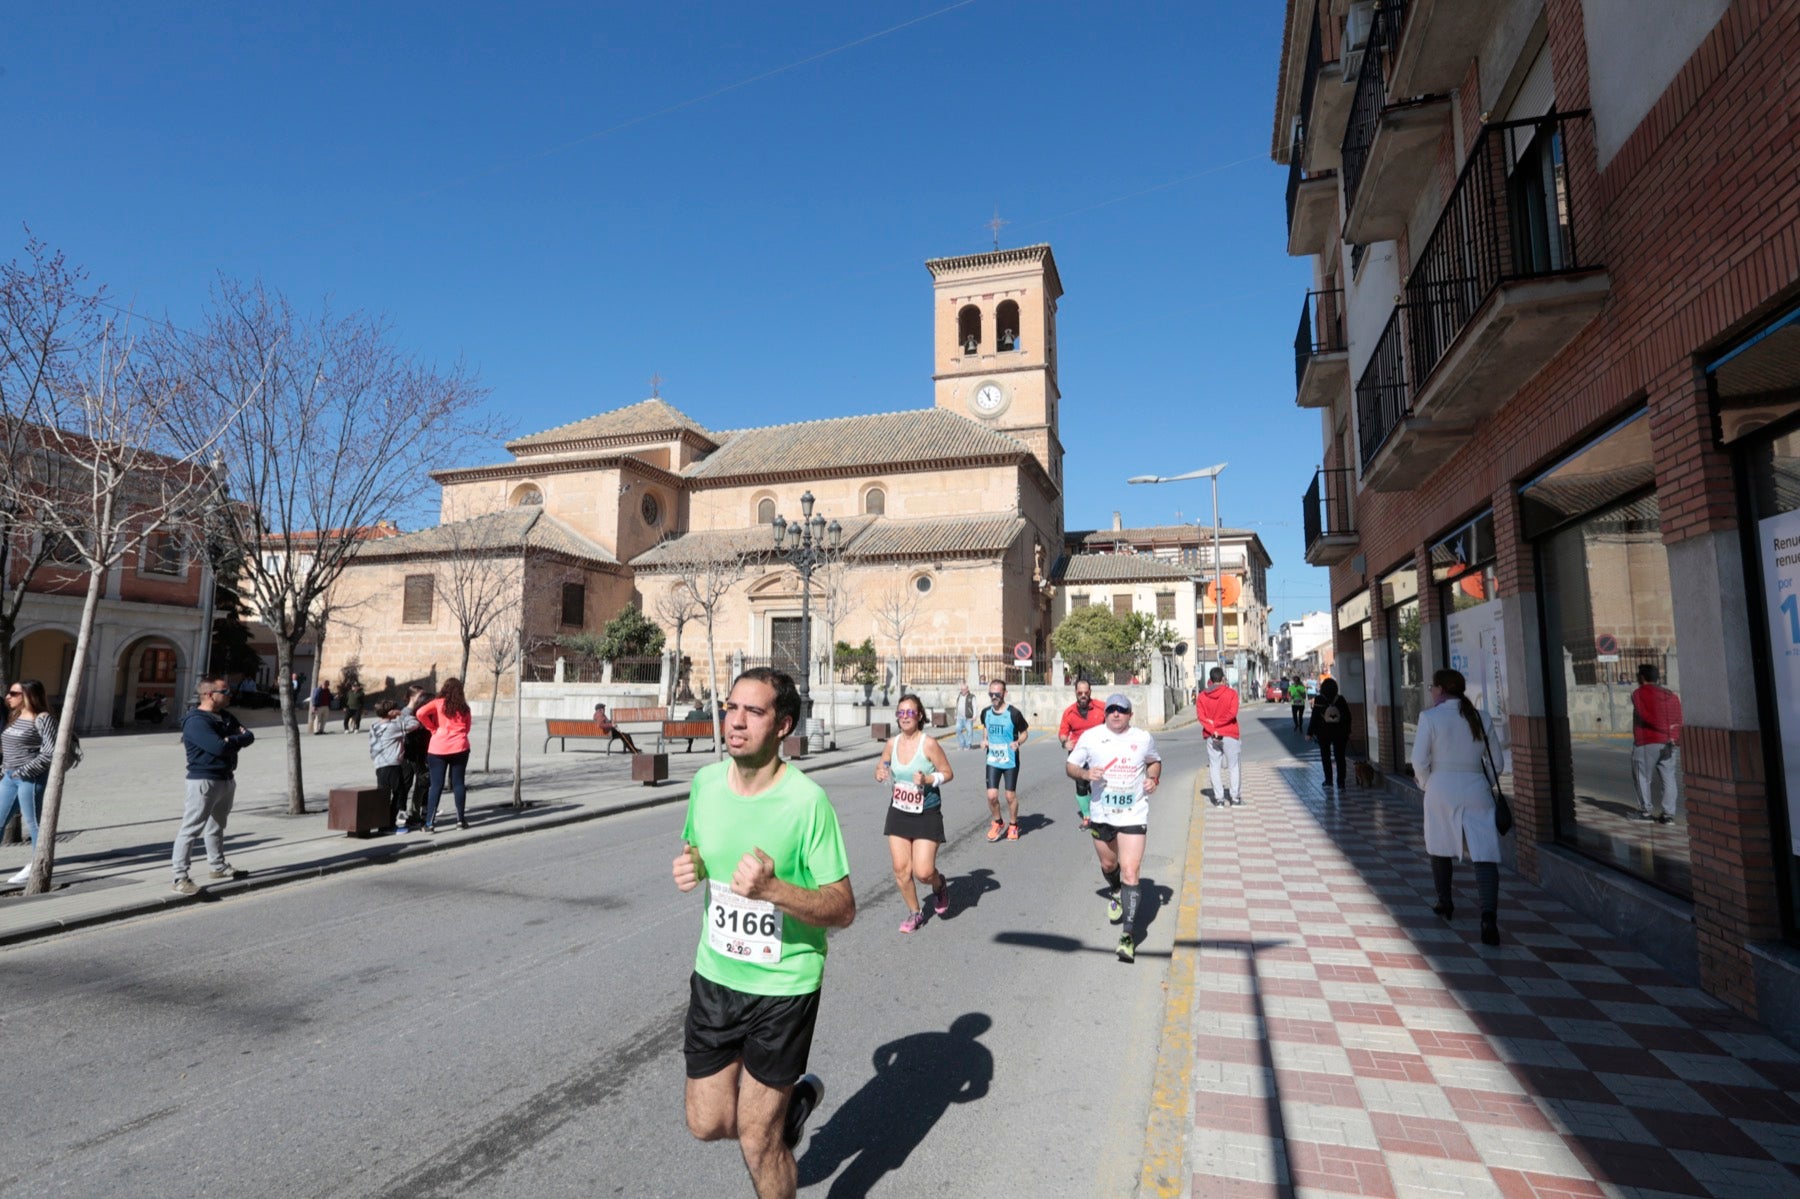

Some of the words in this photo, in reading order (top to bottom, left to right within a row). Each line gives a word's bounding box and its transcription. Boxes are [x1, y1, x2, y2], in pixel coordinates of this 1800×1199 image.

[1778, 577, 1792, 593] por
[894, 788, 922, 804] 2009
[1104, 794, 1133, 805] 1185
[715, 905, 776, 937] 3166
